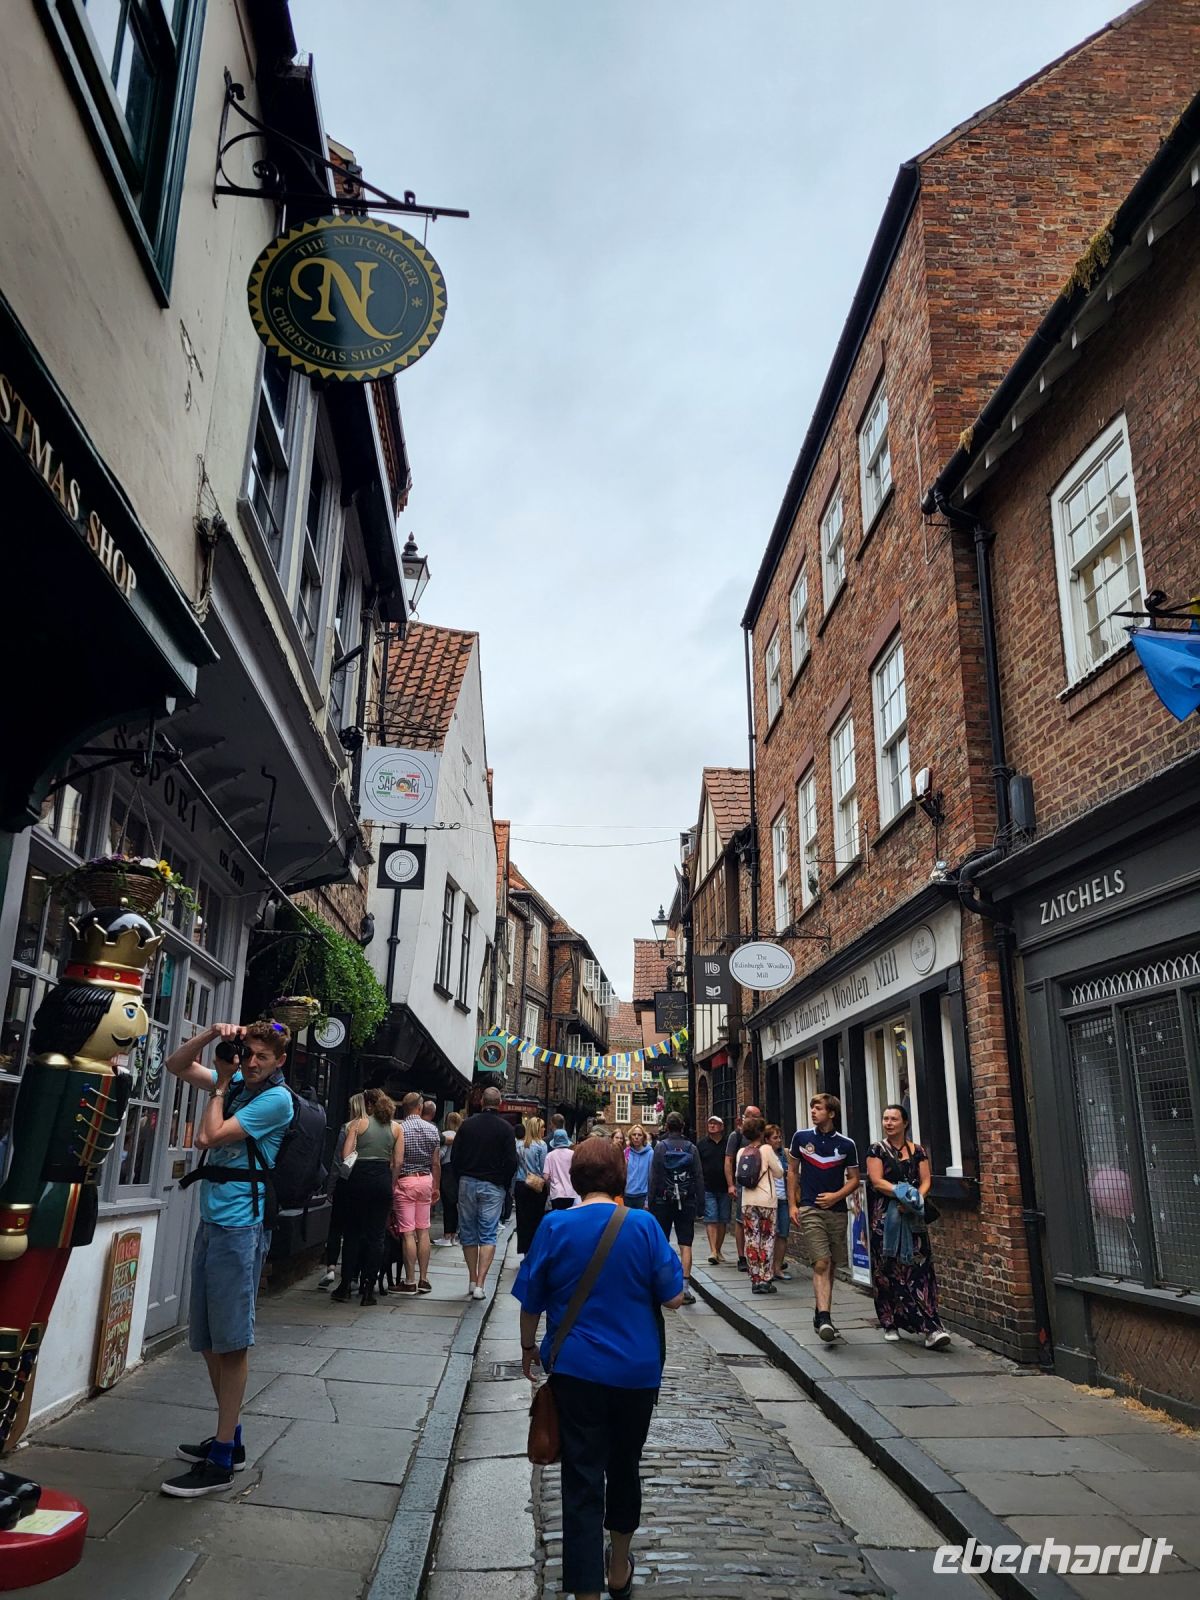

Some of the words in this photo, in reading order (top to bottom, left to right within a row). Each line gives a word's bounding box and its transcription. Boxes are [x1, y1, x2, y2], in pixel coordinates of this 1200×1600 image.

[295, 237, 329, 257] THE
[333, 233, 420, 288] NUTCRACKER
[289, 256, 404, 341] N
[272, 305, 348, 363] CHRISTMAS
[351, 341, 393, 363] SHOP
[86, 510, 138, 600] SHOP
[1039, 868, 1126, 926] ZATCHELS
[734, 961, 765, 970] Edinburgh
[766, 961, 790, 970] Woollen
[756, 953, 768, 961] The
[781, 1018, 793, 1042] The
[793, 992, 831, 1036] Edinburgh
[831, 973, 870, 1012] Woollen
[872, 948, 900, 991] Mill
